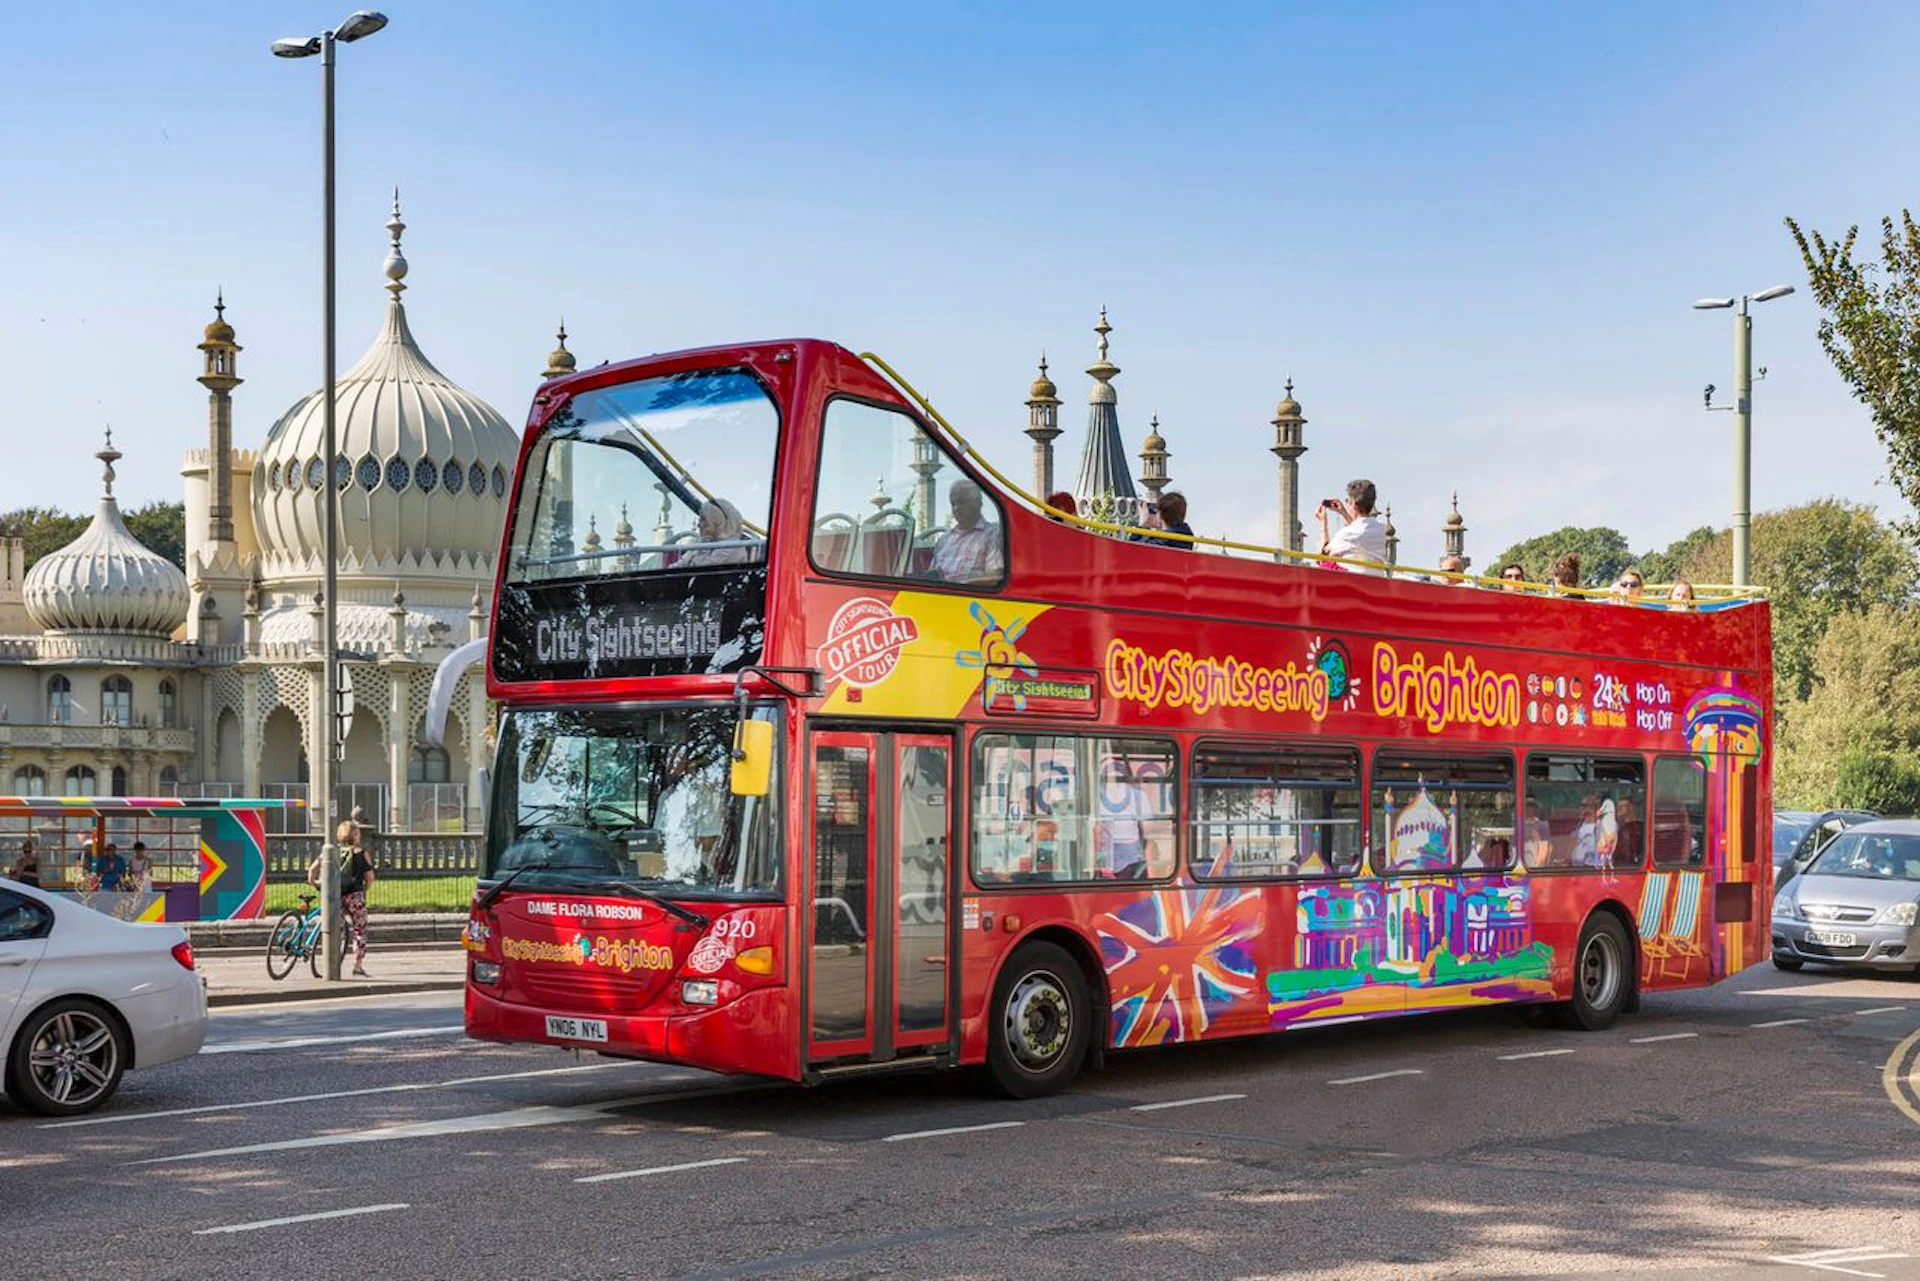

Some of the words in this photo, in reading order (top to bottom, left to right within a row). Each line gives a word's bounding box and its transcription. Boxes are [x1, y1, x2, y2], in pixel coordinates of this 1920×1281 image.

[537, 616, 582, 661] City
[586, 613, 720, 658] Sightseeing
[827, 620, 914, 672] OFFICIAL
[858, 653, 896, 680] TOUR
[1372, 640, 1521, 734] Brighton
[1636, 682, 1656, 706] Hop
[1657, 682, 1671, 705] On
[1636, 708, 1656, 732] Hop
[1657, 709, 1673, 731] Off
[527, 900, 557, 916] DAME
[558, 902, 595, 918] FLORA
[596, 904, 643, 920] ROBSON
[714, 918, 756, 939] 920
[596, 936, 673, 973] Brighton
[548, 1018, 577, 1036] YN06
[581, 1020, 605, 1039] NYL
